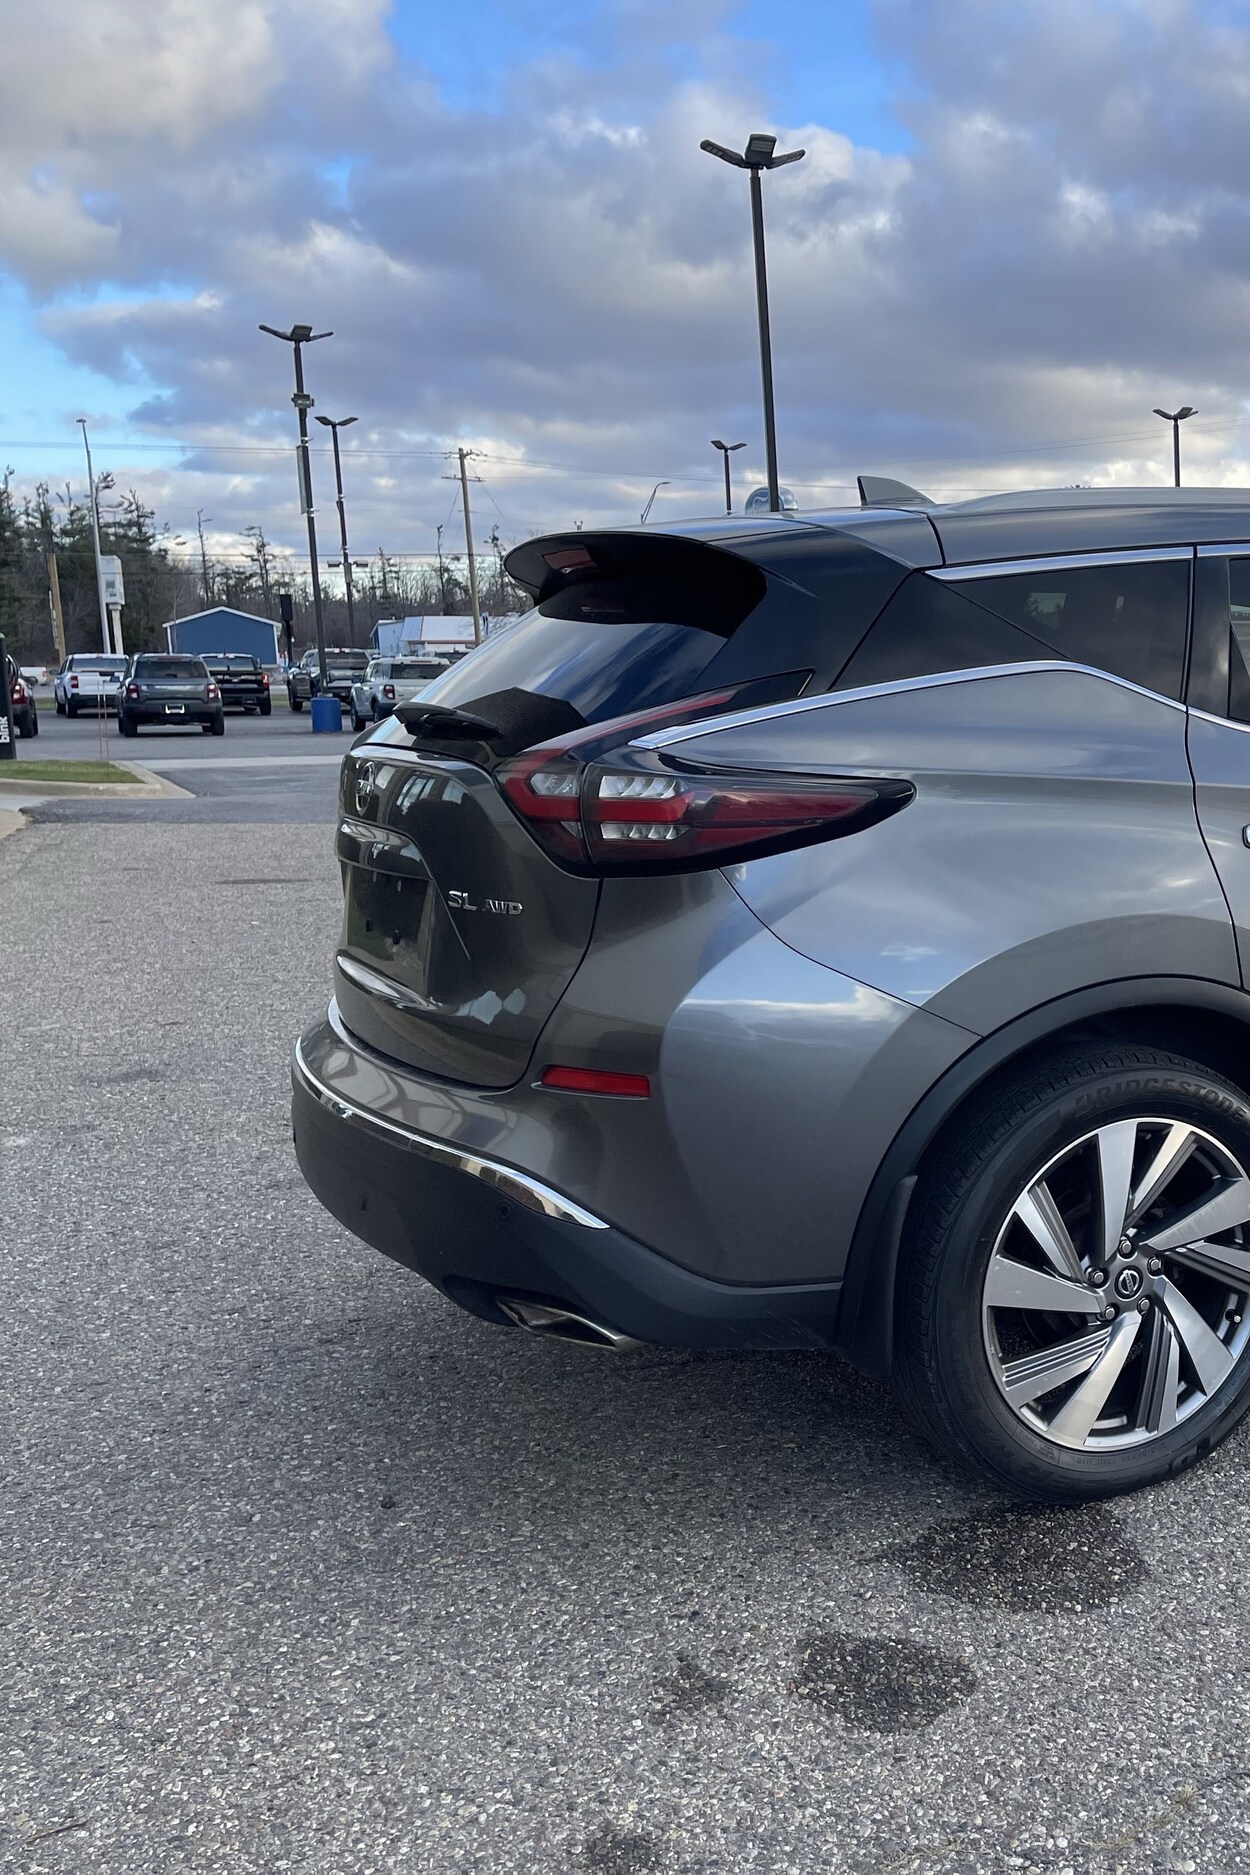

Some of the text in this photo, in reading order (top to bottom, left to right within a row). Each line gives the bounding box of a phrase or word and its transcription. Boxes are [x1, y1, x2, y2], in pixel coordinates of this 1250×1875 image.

[448, 889, 523, 916] SL AWD
[1074, 1078, 1248, 1124] BRIDGESTONE
